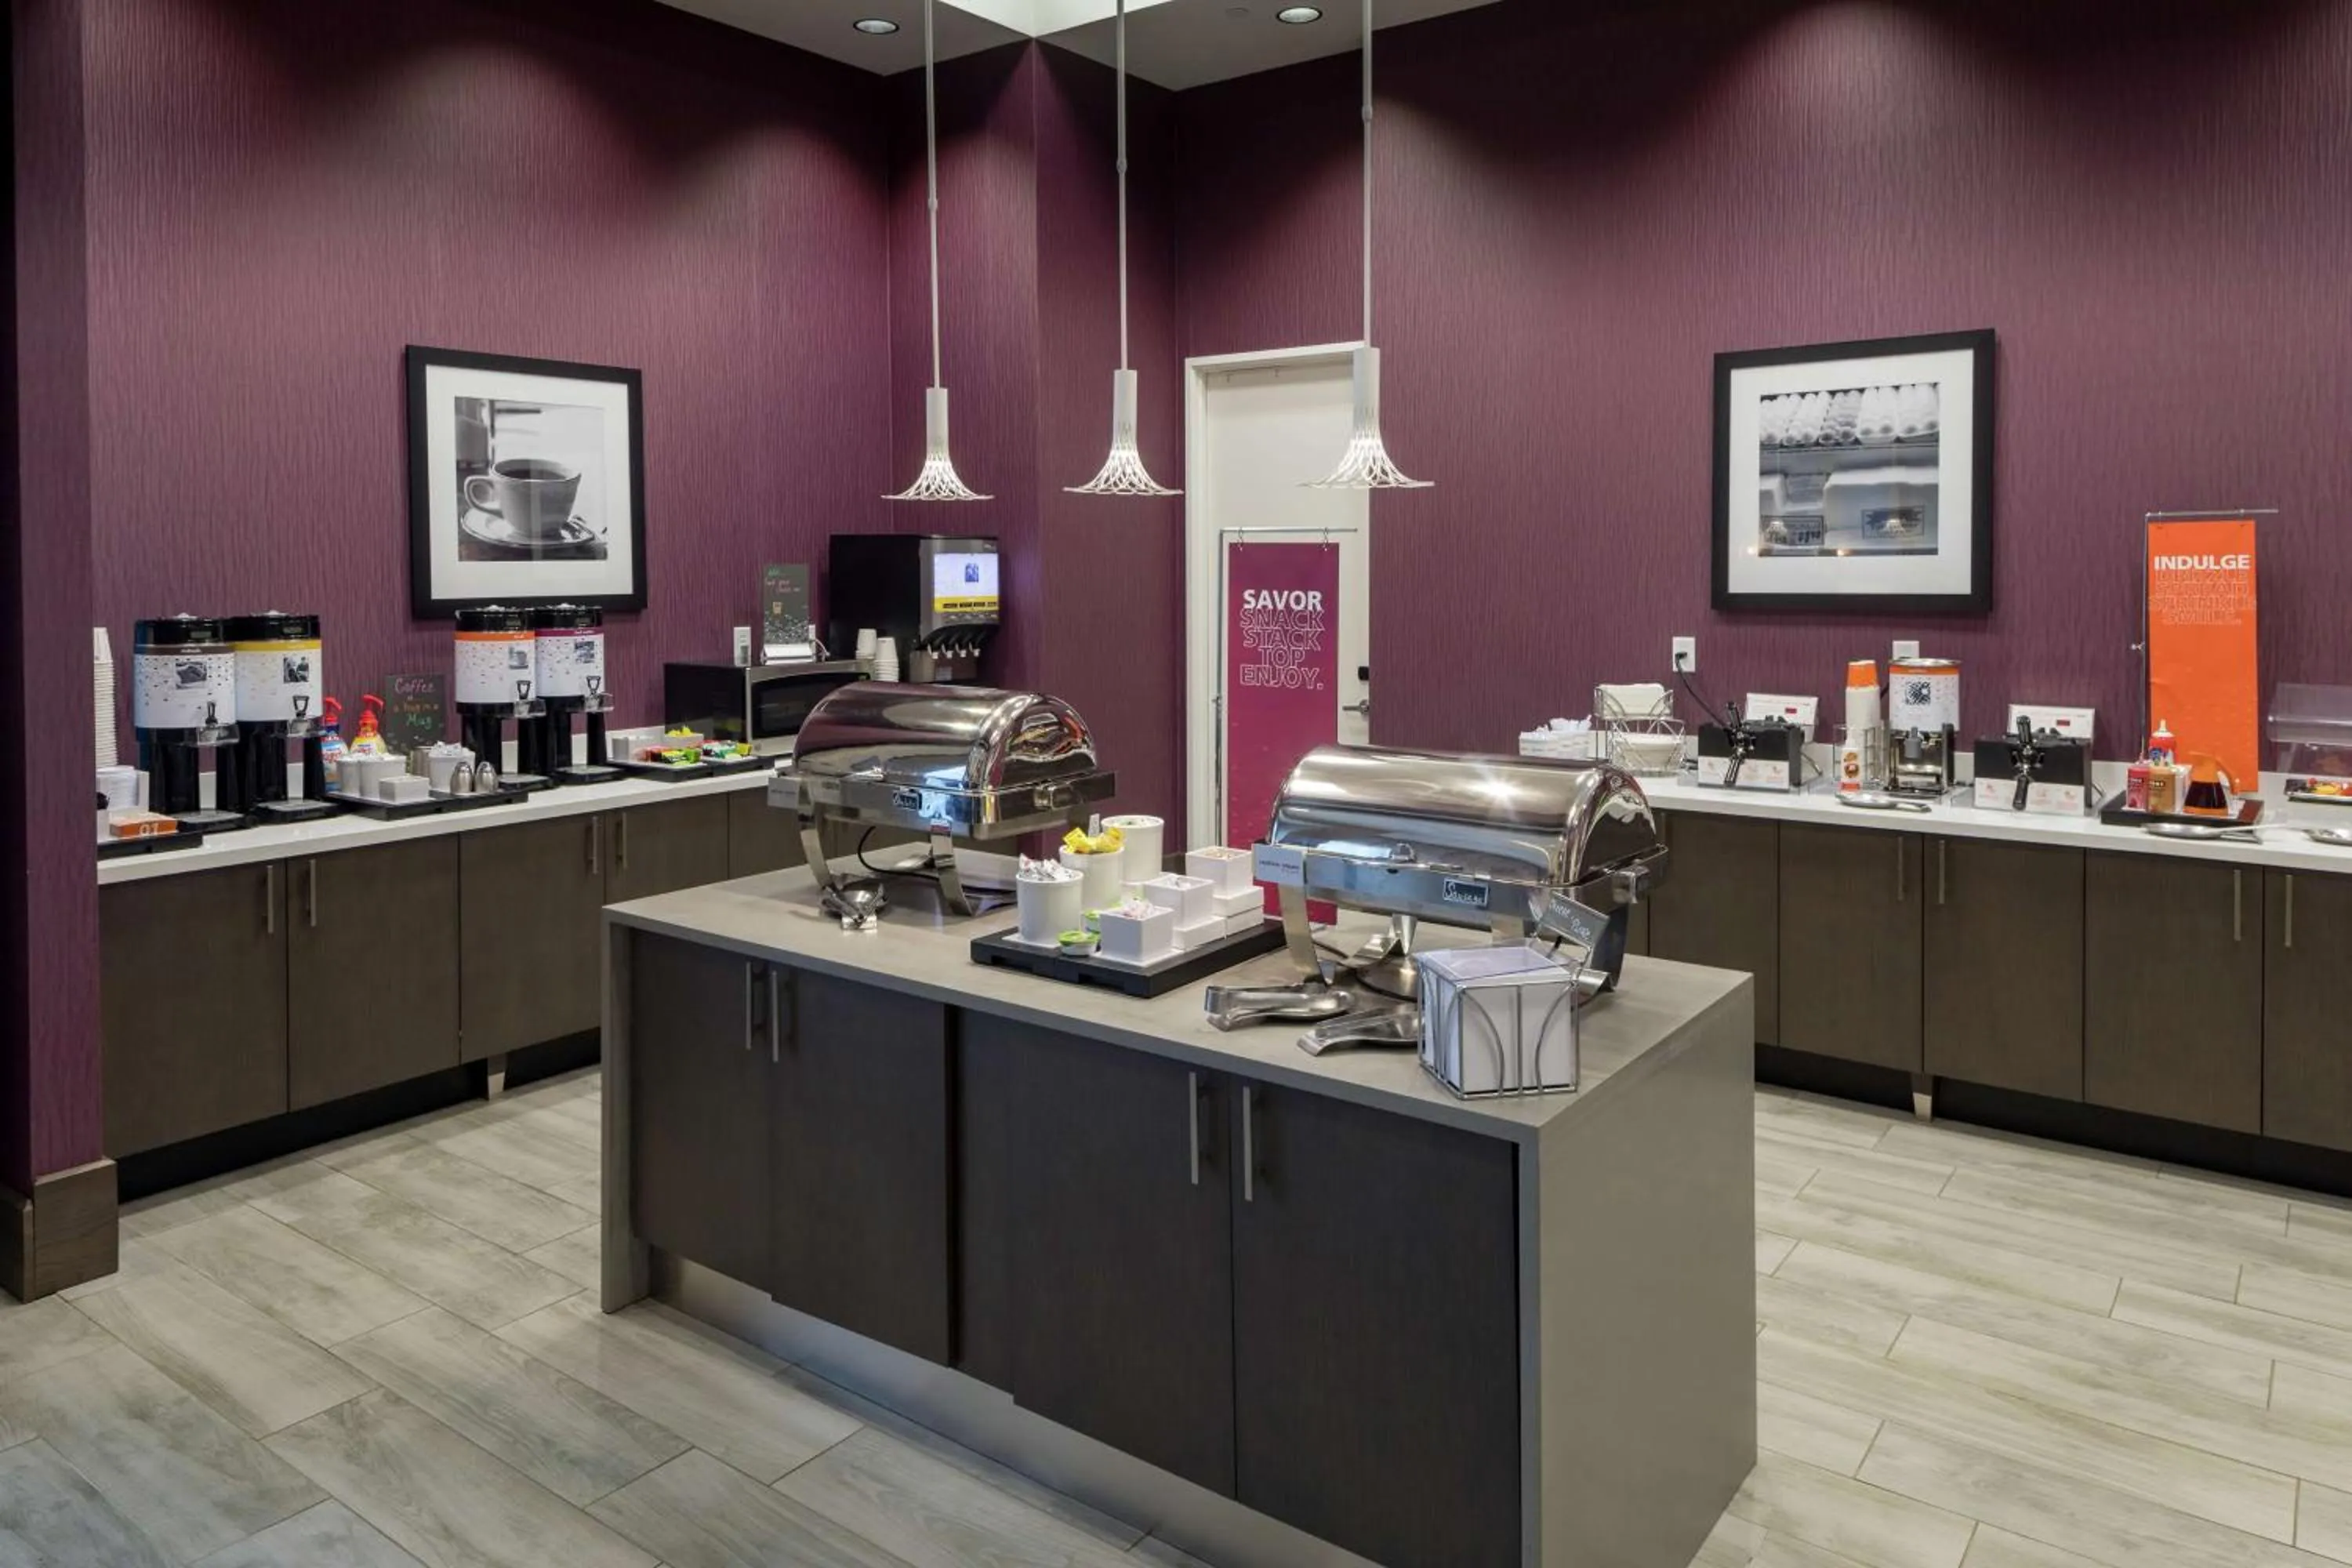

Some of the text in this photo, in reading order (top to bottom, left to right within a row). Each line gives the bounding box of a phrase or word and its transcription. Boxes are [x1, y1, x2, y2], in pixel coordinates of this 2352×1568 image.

[2154, 554, 2252, 571] INDULGE
[1243, 590, 1323, 611] SAVOR
[1240, 608, 1325, 631] SNACK
[1243, 627, 1321, 652] STACK
[1258, 646, 1305, 669] TOP
[1240, 664, 1323, 690] ENJOY.
